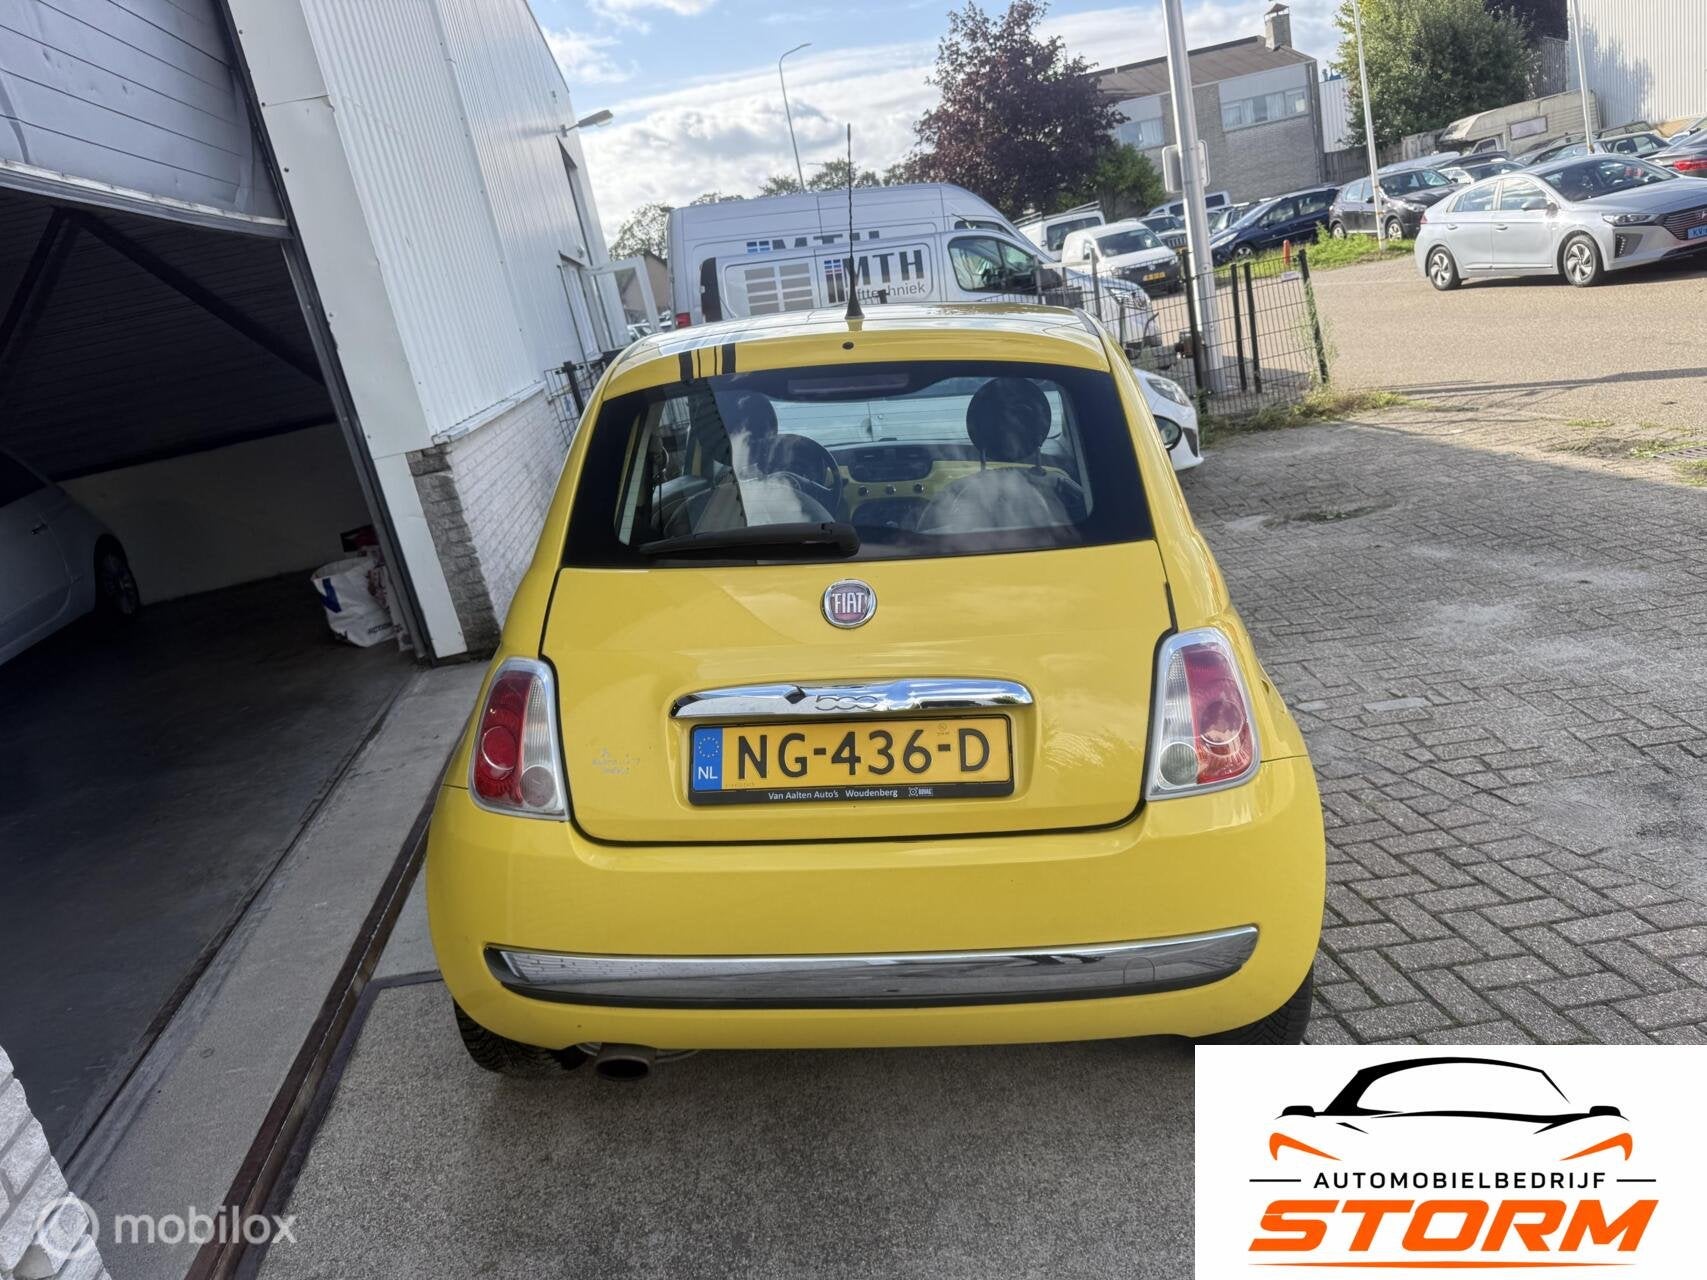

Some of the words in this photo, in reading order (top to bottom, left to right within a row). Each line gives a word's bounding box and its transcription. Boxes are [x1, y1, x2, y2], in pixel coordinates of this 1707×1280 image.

[842, 250, 925, 287] MTH
[832, 592, 865, 614] FIAT
[737, 727, 990, 780] NG-436-D
[698, 766, 718, 780] NL
[768, 791, 784, 800] Van
[785, 791, 812, 800] Aalten
[845, 788, 898, 798] Woudenberg
